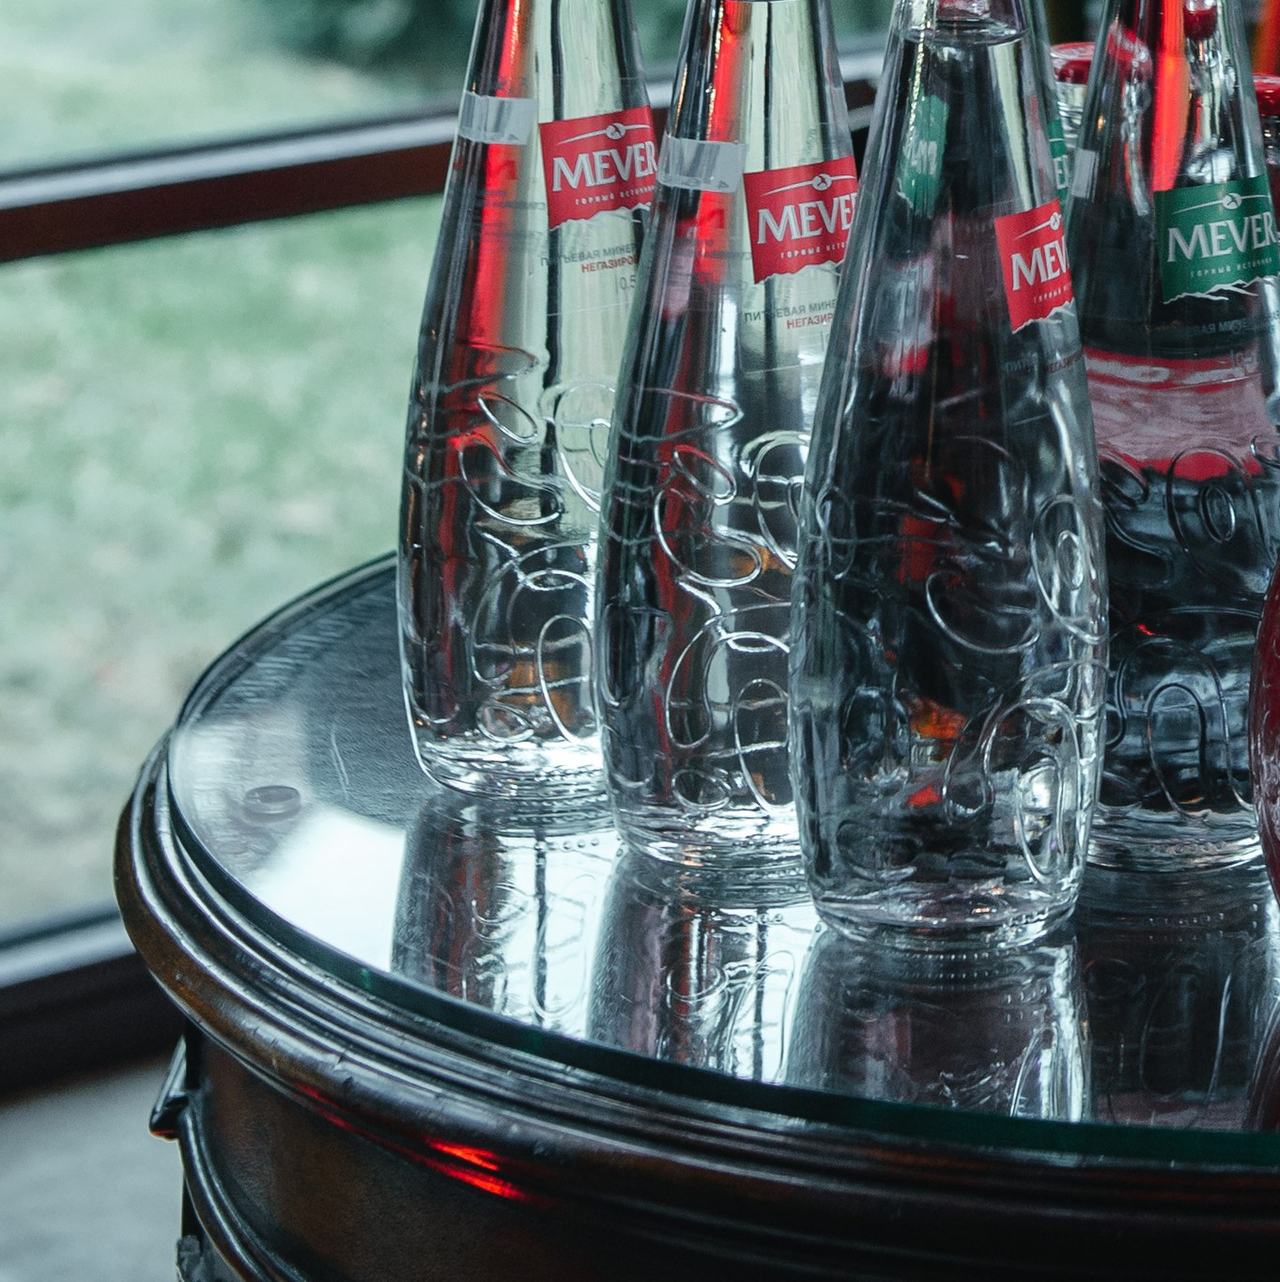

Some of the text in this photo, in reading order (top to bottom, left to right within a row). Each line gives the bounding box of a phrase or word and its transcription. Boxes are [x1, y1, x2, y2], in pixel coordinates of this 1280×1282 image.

[552, 141, 659, 192] MEVER
[757, 192, 859, 245] MEVE
[1167, 212, 1277, 263] MEVER
[1011, 235, 1070, 291] MEV
[787, 313, 834, 330] НЕГАЗИР
[809, 299, 837, 313] МИНЕ
